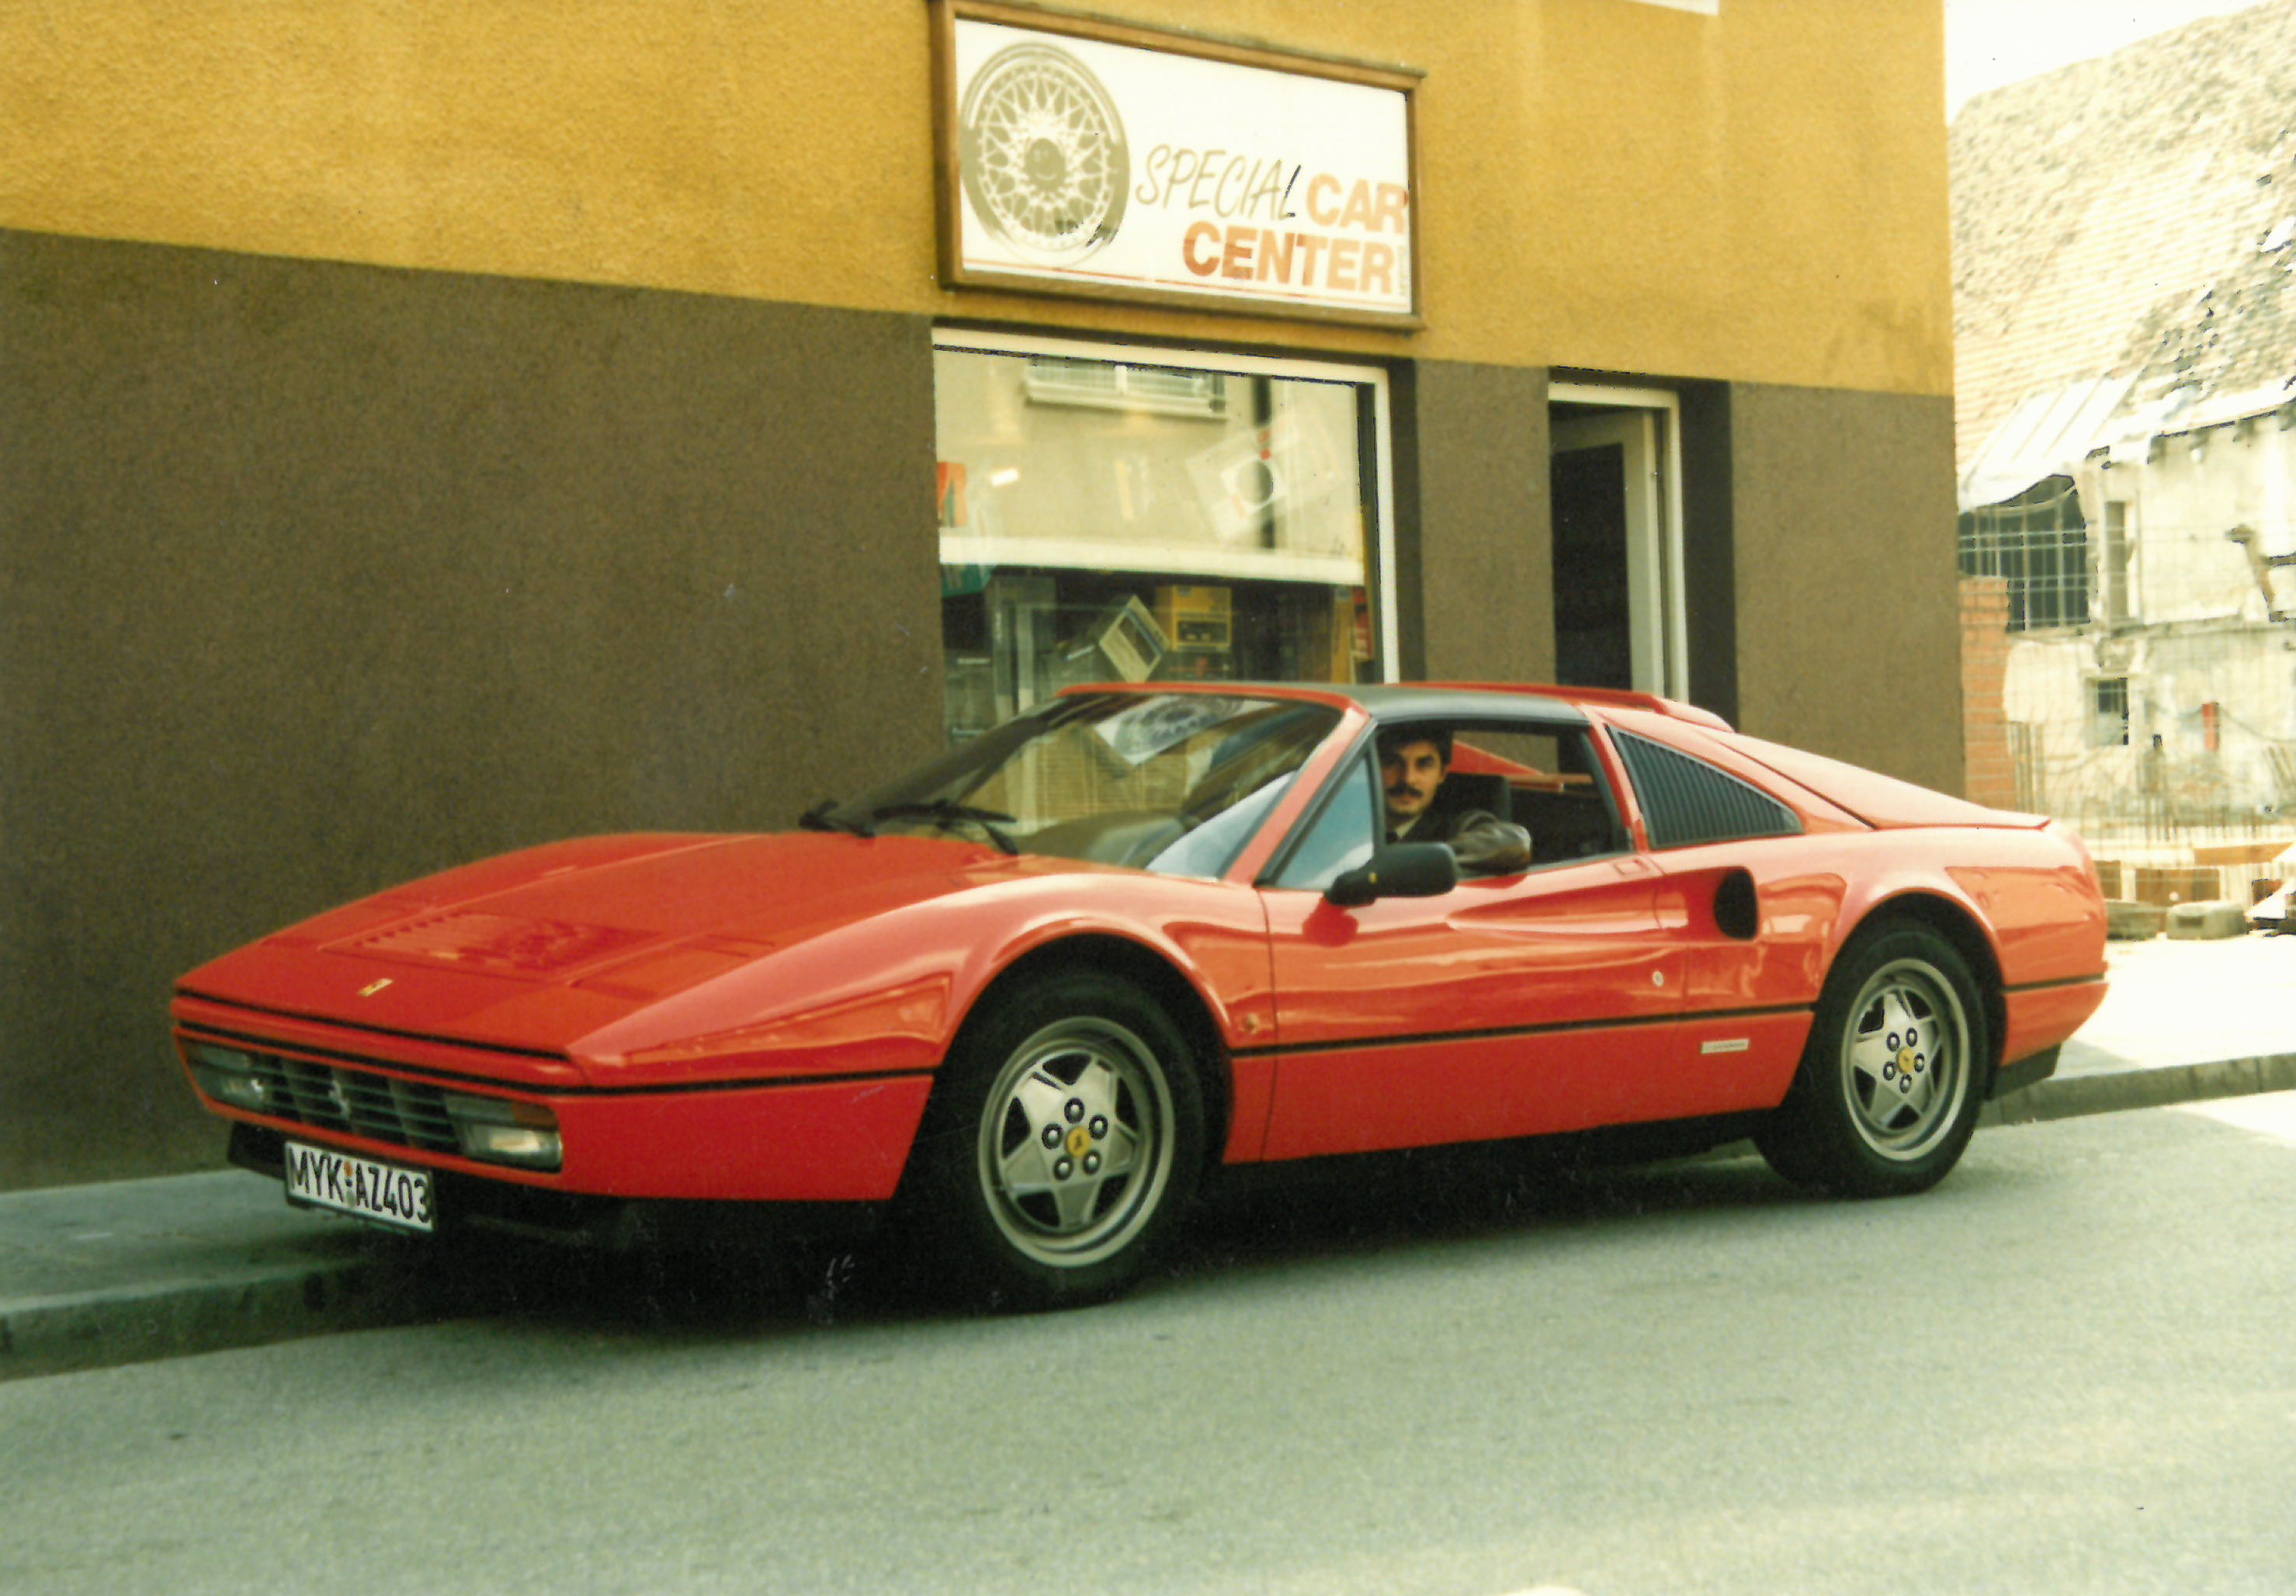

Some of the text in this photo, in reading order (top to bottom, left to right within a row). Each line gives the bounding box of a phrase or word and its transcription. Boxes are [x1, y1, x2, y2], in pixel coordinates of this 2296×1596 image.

[1136, 144, 1407, 234] SPECIAL CAR
[1182, 220, 1395, 294] CENTER
